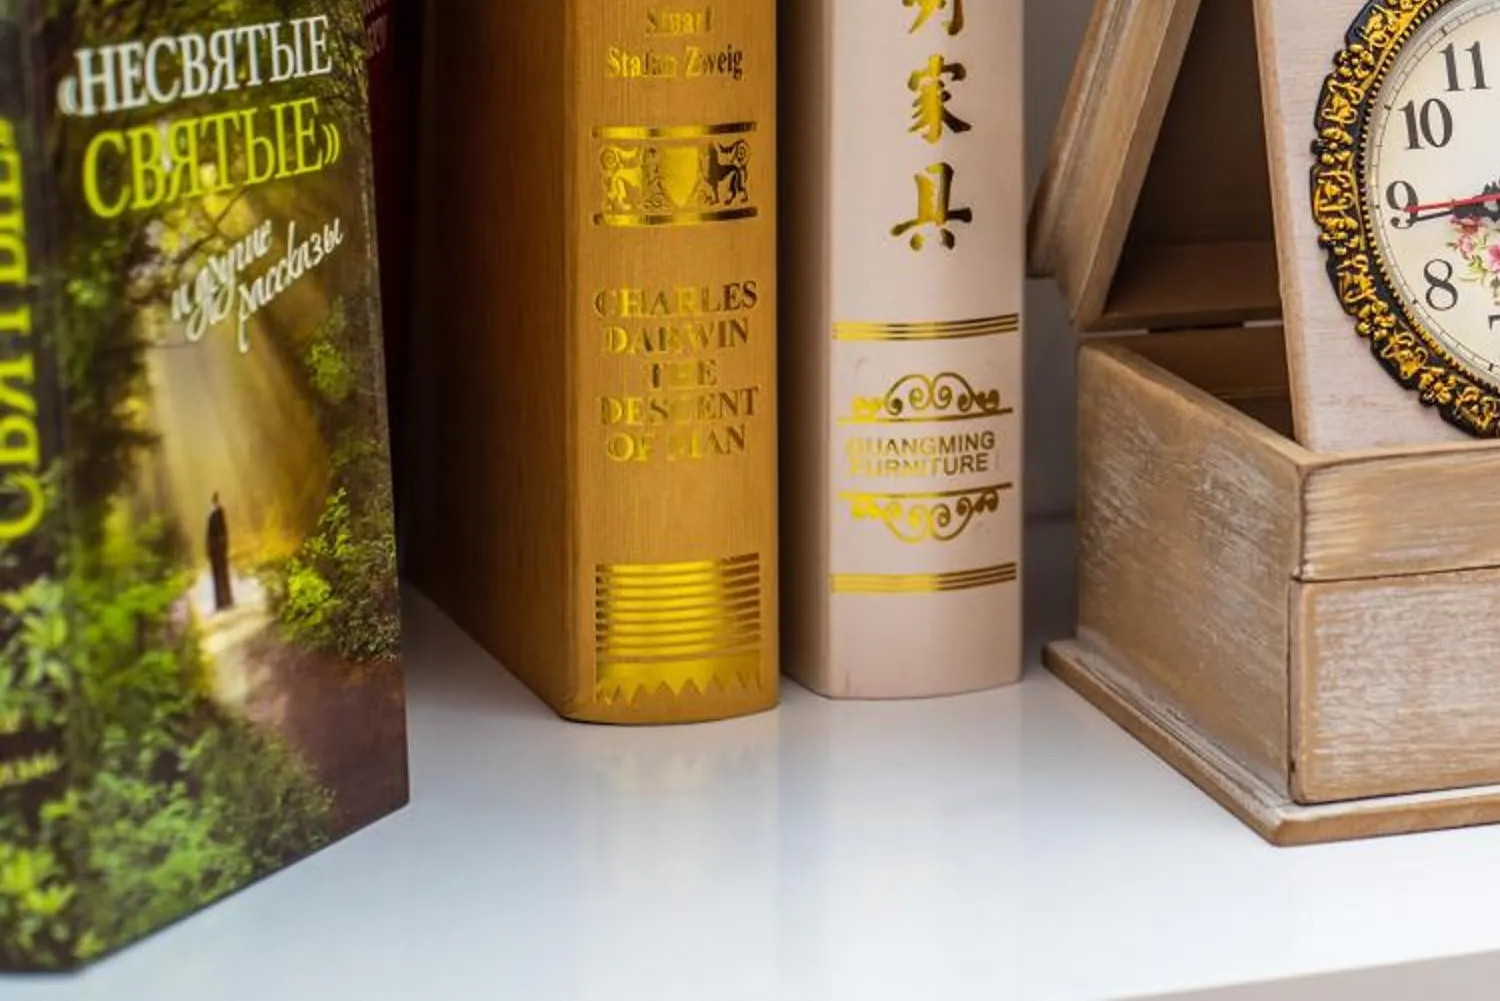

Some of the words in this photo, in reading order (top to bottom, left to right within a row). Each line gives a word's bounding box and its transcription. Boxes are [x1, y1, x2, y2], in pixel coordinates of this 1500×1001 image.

[58, 16, 333, 116] «НЕСВЯТЫЕ
[685, 45, 744, 80] Zweig
[1439, 41, 1491, 92] 11
[1399, 97, 1454, 150] 10
[84, 97, 341, 219] СВЯТЫЕ»
[1386, 179, 1419, 230] 9
[238, 217, 344, 354] рассказы
[594, 280, 758, 319] CHARLES
[1423, 258, 1459, 312] 8
[606, 317, 749, 354] DARWIN
[601, 386, 761, 426] DESCENT
[606, 432, 655, 462] OF
[666, 424, 746, 460] MAN
[845, 430, 995, 457] GUANGMING
[850, 452, 989, 477] FURNITURE
